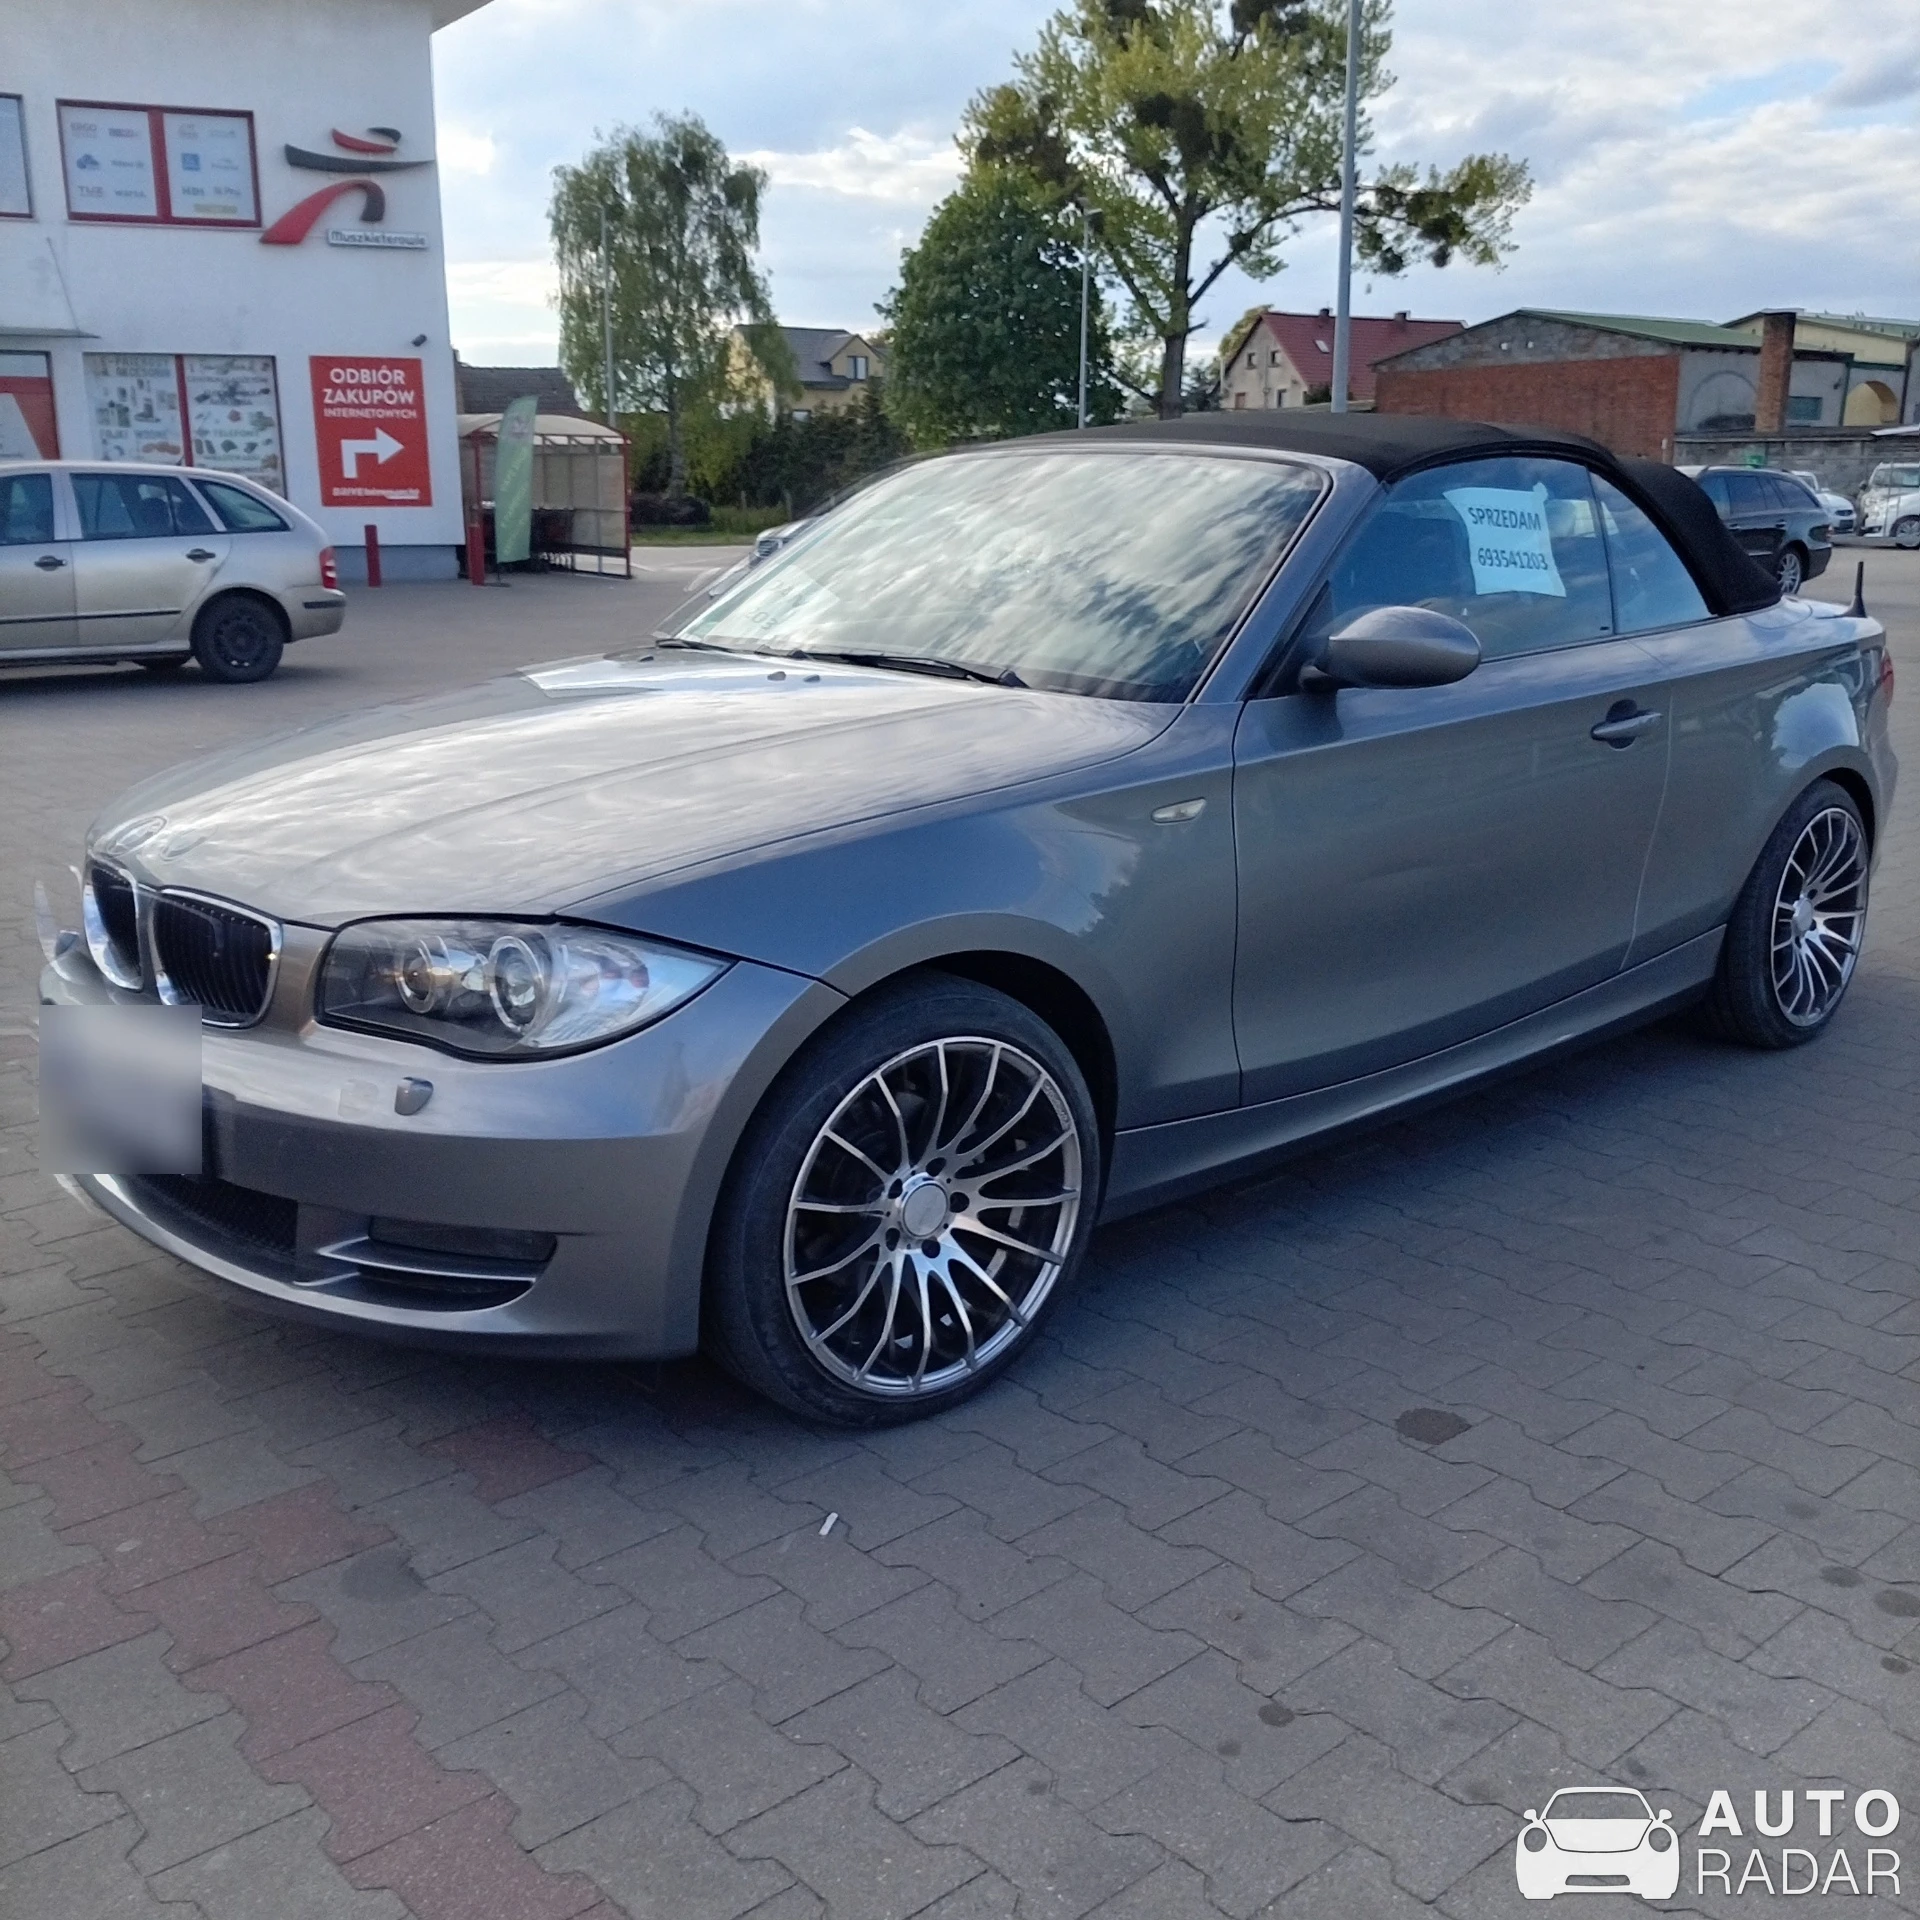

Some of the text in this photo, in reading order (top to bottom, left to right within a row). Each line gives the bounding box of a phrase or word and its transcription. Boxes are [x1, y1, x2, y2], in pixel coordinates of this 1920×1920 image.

[330, 365, 405, 384] ODBIÓR
[323, 386, 414, 405] ZAKUPÓW
[323, 408, 416, 418] INTERNETOWYCH
[1467, 506, 1542, 531] SPRZEDAM
[1477, 547, 1548, 570] 693541203
